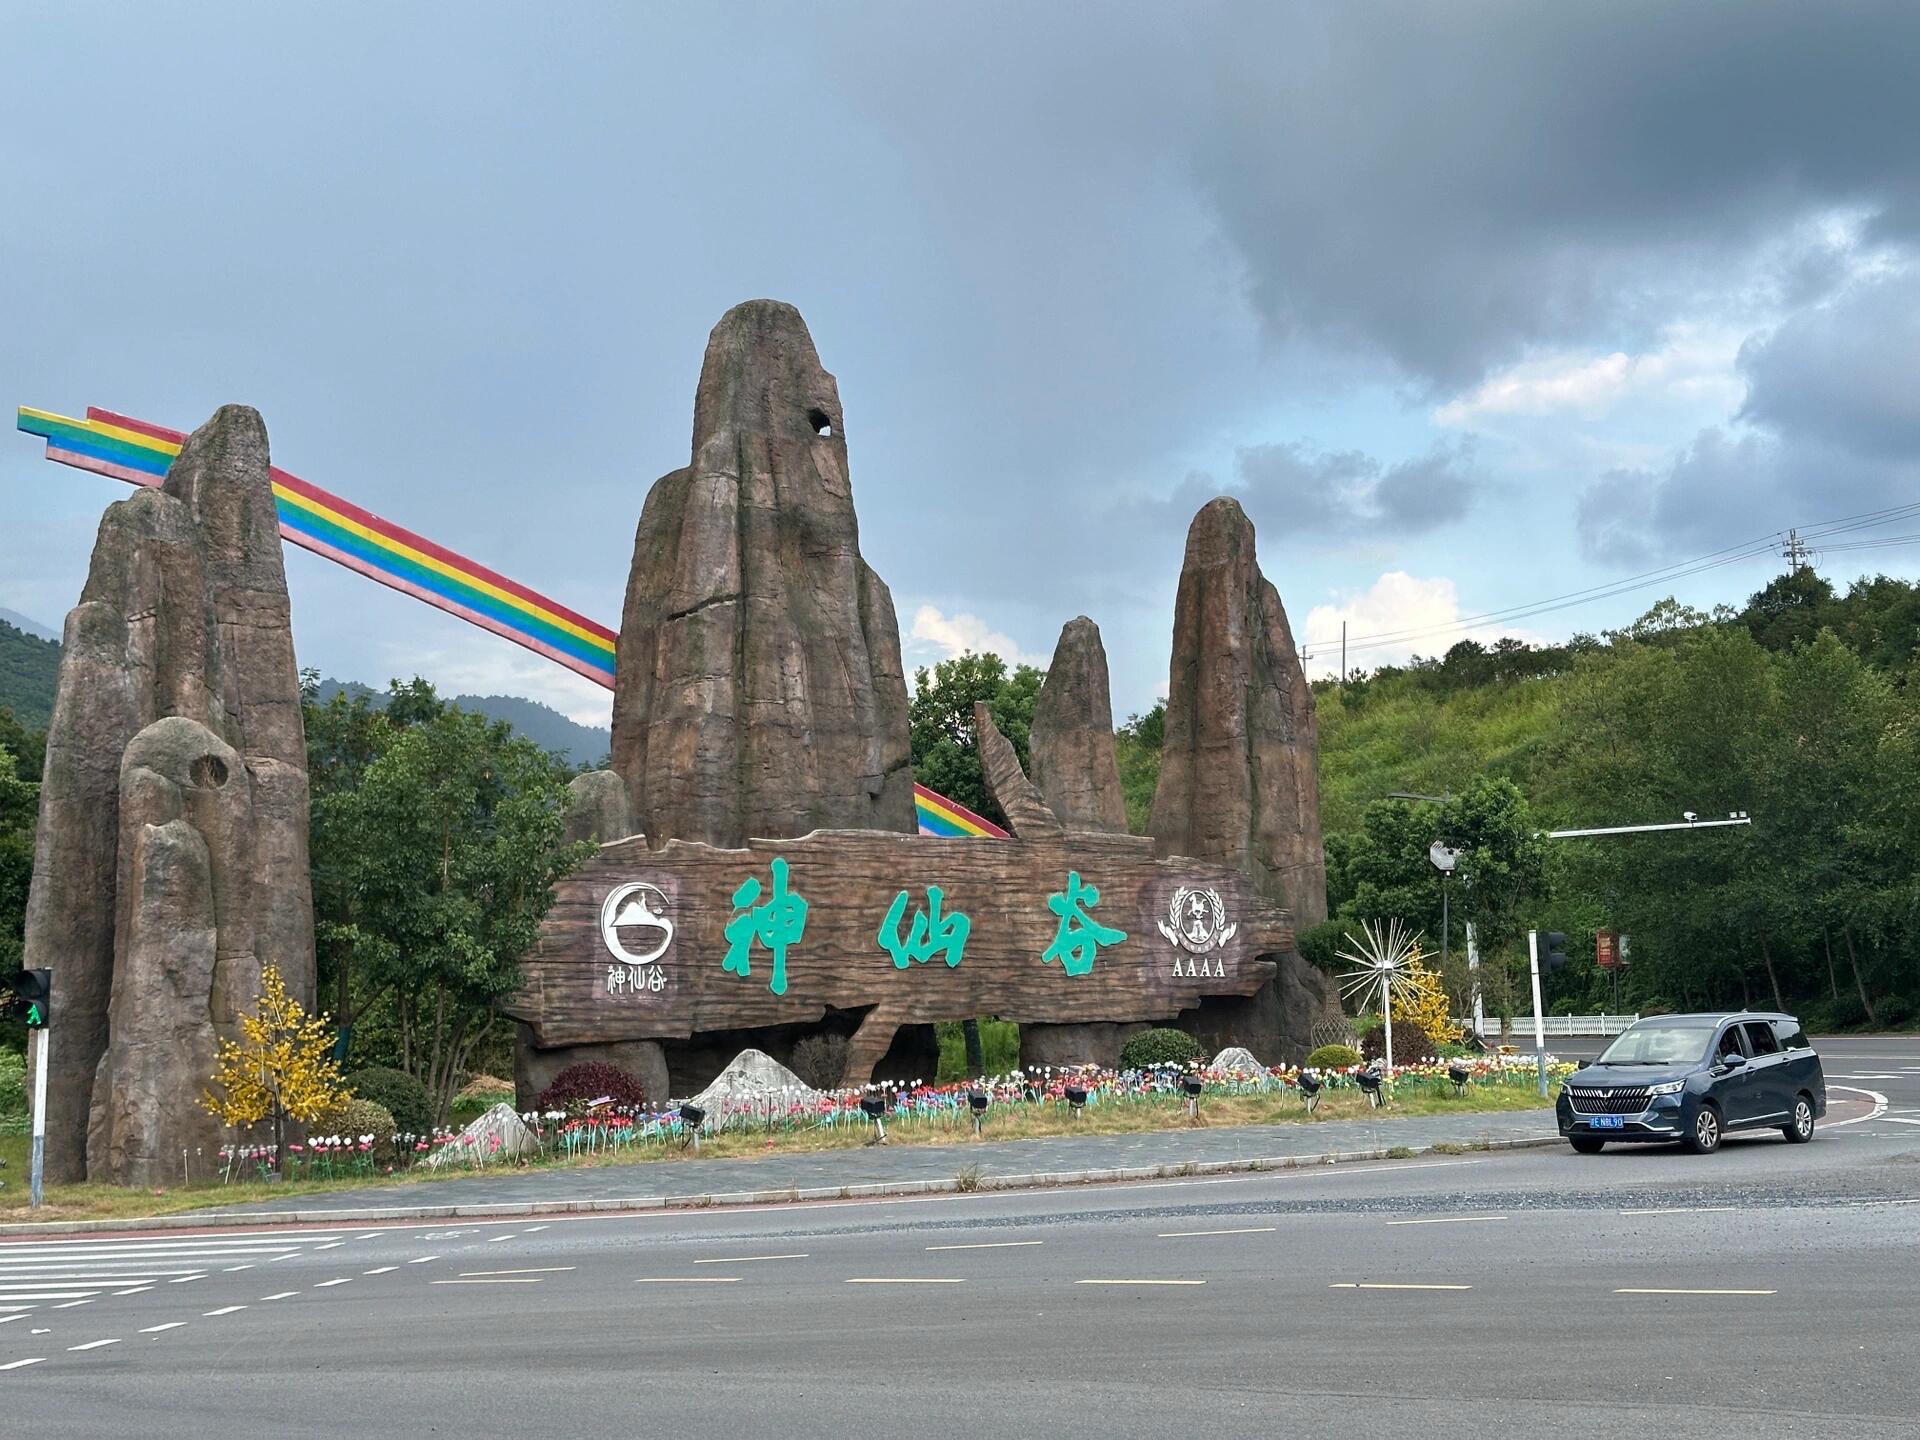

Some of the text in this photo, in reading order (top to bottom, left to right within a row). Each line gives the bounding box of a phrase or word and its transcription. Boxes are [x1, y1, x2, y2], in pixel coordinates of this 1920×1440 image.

[722, 857, 1128, 996] 神仙谷
[607, 964, 668, 995] 神仙谷
[1171, 957, 1226, 977] AAAA
